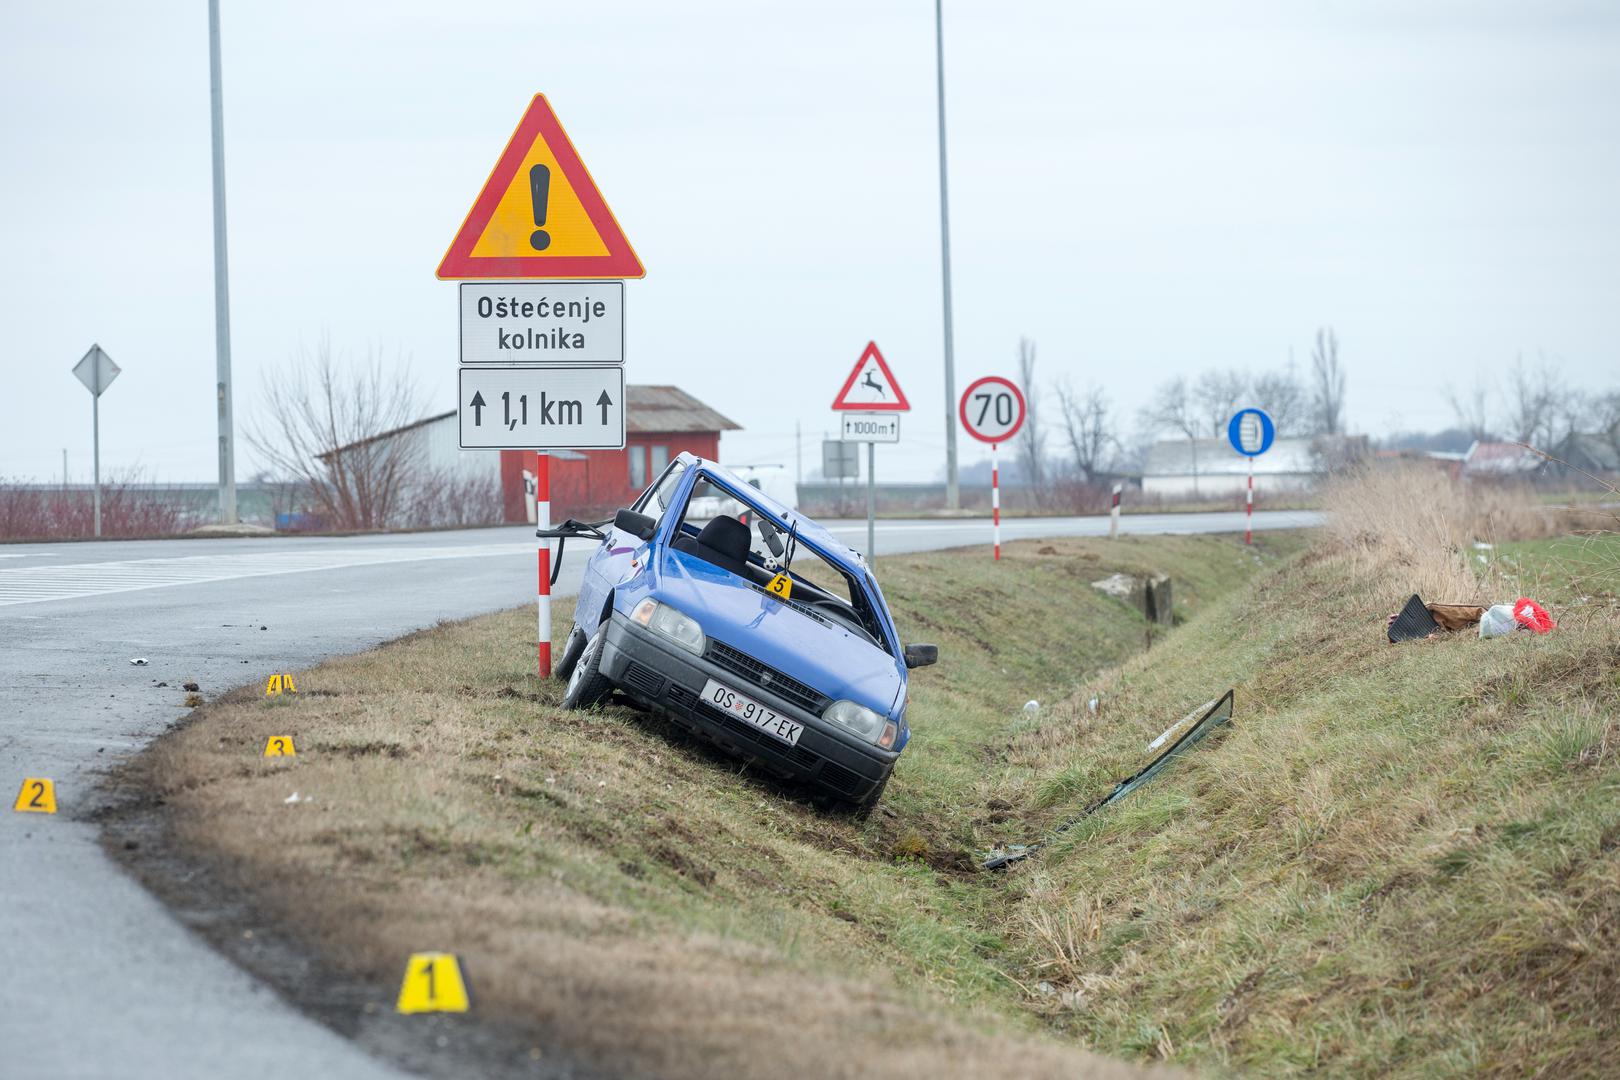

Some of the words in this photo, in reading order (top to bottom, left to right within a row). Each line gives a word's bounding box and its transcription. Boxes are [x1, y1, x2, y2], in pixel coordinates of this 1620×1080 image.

[478, 296, 605, 323] Oštećenje
[499, 327, 585, 349] kolnika
[502, 391, 527, 431] 1,1
[541, 391, 582, 425] km
[975, 393, 1012, 426] 70
[774, 577, 787, 592] 5
[713, 688, 735, 708] OS
[743, 703, 800, 742] 917-EK
[274, 739, 284, 756] 3
[30, 782, 47, 807] 2
[420, 961, 436, 1001] 1
